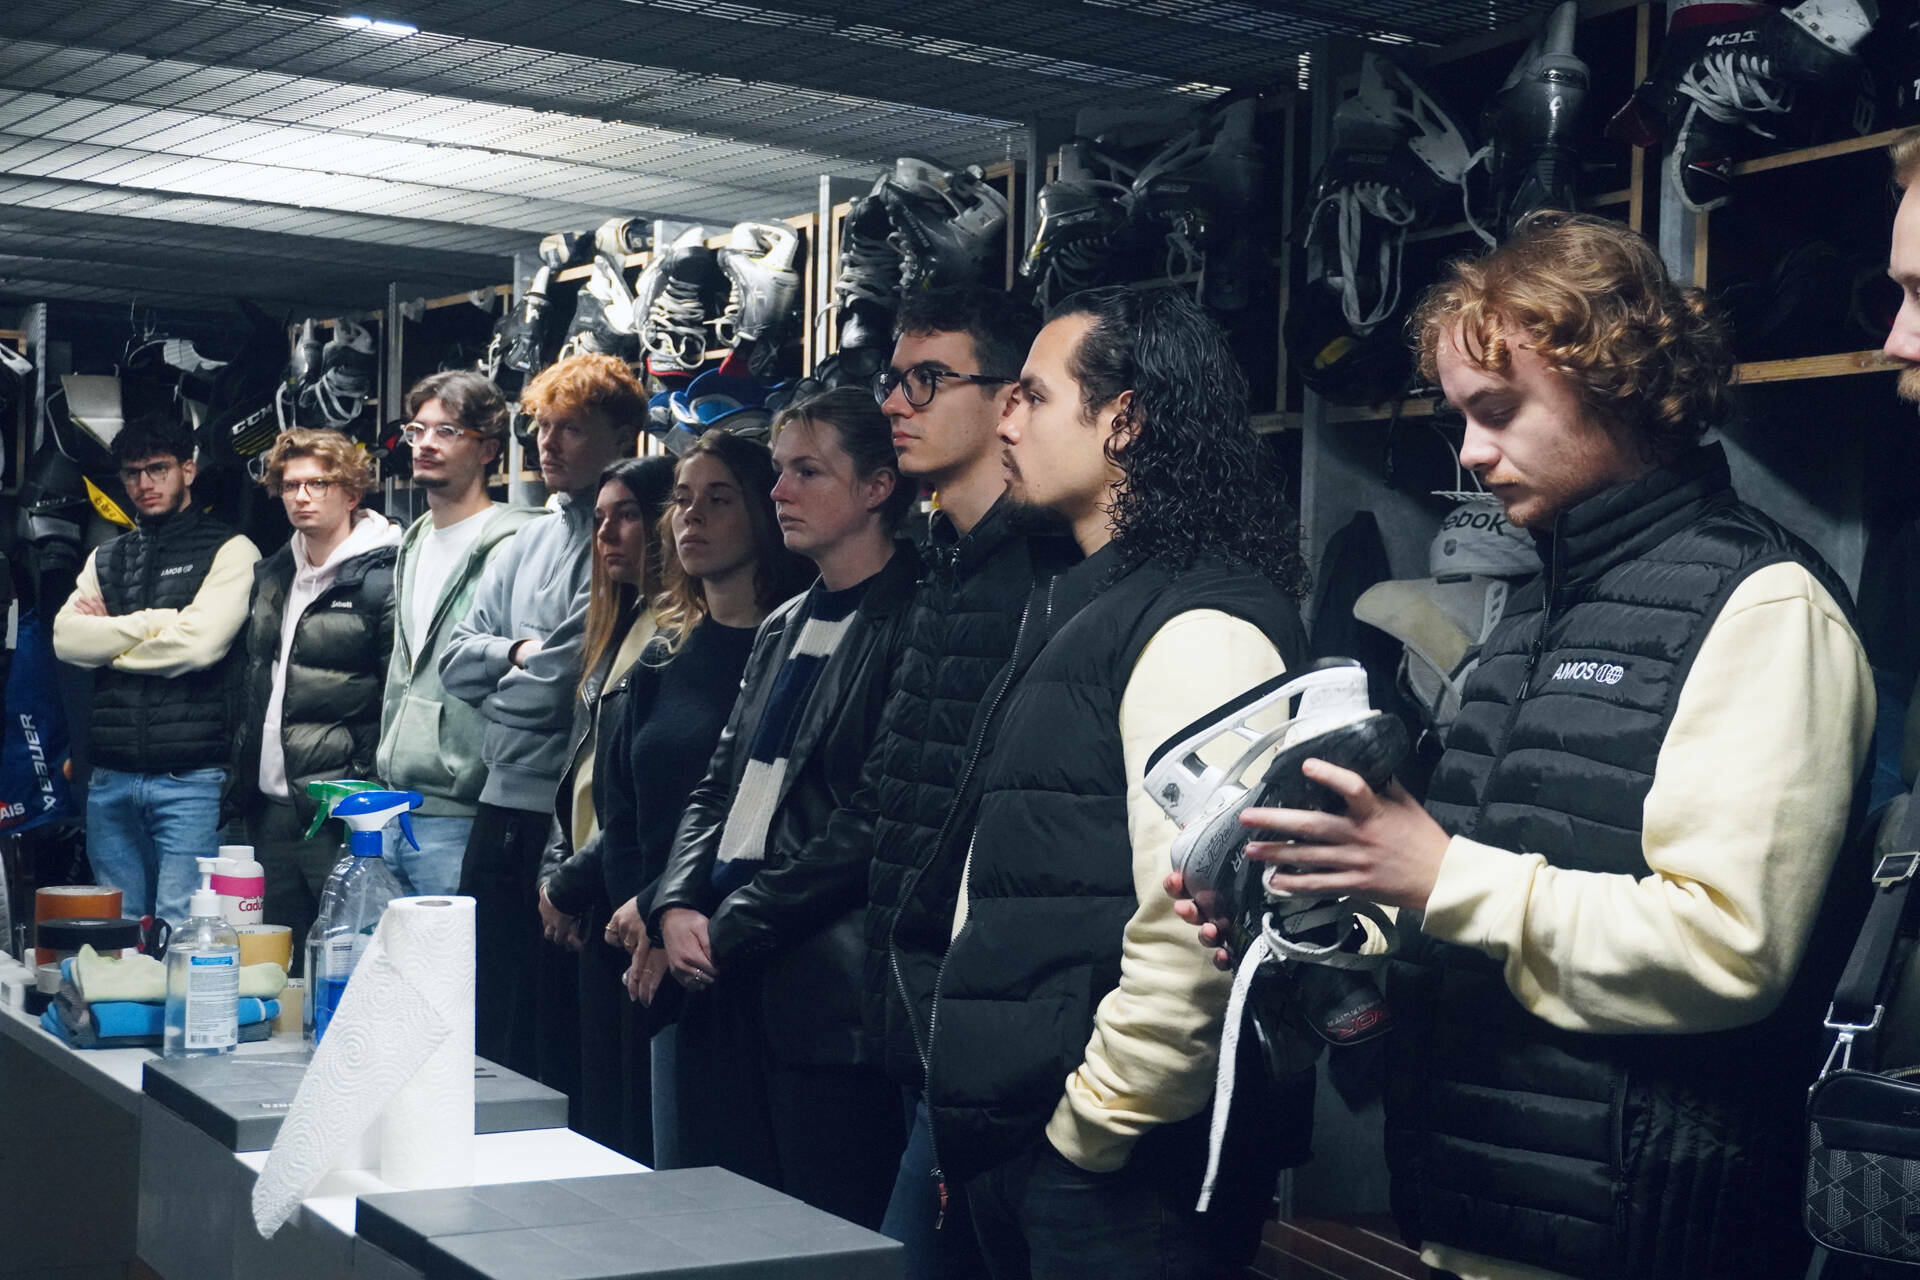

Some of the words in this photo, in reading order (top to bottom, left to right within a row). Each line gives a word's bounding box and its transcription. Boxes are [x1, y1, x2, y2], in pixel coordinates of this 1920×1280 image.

[1706, 30, 1757, 47] CCM
[1443, 510, 1507, 536] ebok
[1552, 662, 1598, 680] AMOS
[238, 900, 264, 912] Cadu
